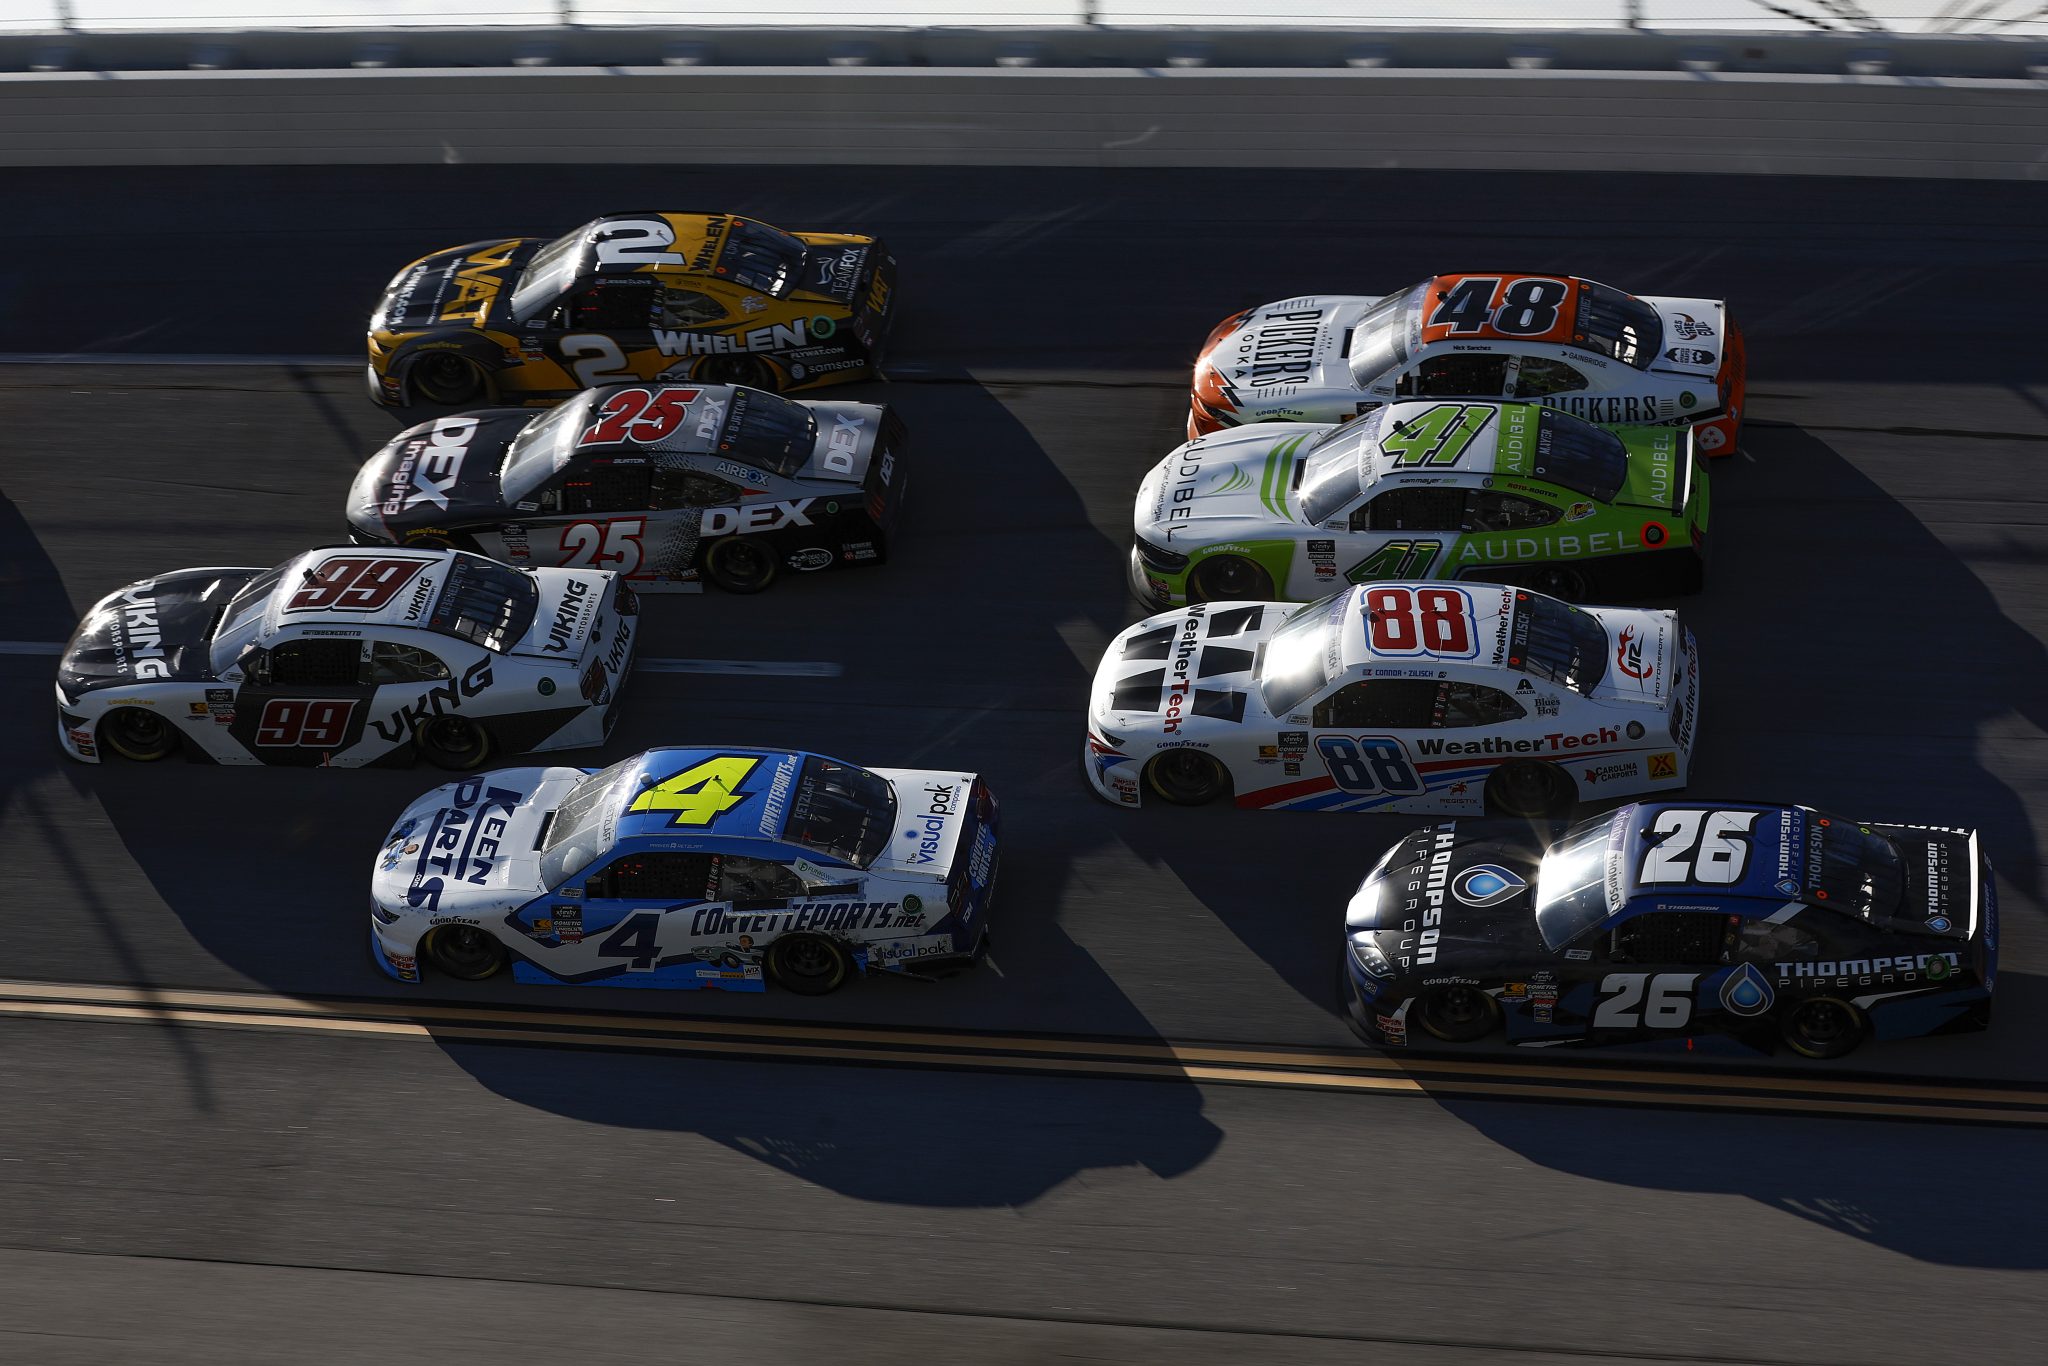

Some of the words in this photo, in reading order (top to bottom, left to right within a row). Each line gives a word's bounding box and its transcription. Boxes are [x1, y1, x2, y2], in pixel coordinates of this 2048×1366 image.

[594, 219, 686, 266] 2
[689, 217, 728, 272] WHELEN
[439, 240, 523, 332] WAT
[866, 266, 888, 314] WAT
[1427, 278, 1567, 335] 48
[558, 333, 641, 388] 2
[652, 317, 809, 358] WHELEN
[790, 347, 845, 359] FLYWAT.COM
[1249, 309, 1323, 388] PICKERS
[1568, 352, 1608, 369] GAINBRIDGE
[807, 358, 865, 374] samsara
[575, 387, 704, 450] 25
[696, 396, 727, 442] DEX
[1255, 407, 1304, 417] GOODYEAR
[1379, 404, 1498, 468] 41
[1507, 406, 1526, 473] AUDIBEL
[402, 417, 481, 512] DEX
[823, 412, 865, 476] DEX
[879, 446, 896, 489] DEX
[1651, 433, 1669, 504] AUDIBEL
[383, 440, 427, 516] imaging
[1167, 438, 1208, 543] AUDIBEL
[699, 497, 818, 538] DEX
[557, 515, 647, 581] 25
[1202, 544, 1251, 555] GOODYEAR
[1344, 539, 1444, 586] 41
[1458, 530, 1640, 561] AUDIBEL
[284, 558, 426, 610] 99
[404, 576, 434, 622] VIKING
[122, 581, 173, 680] VIKING
[543, 578, 589, 653] VIKING
[575, 592, 598, 641] MOTORSPORTS
[1367, 589, 1470, 653] 88
[1492, 590, 1513, 666] WeatherTech
[1514, 611, 1531, 647] ZILISCH
[1164, 602, 1207, 734] WeatherTech
[1409, 670, 1433, 678] ZILISCH
[1655, 626, 1665, 698] MOTORSPORTS
[255, 700, 355, 747] 99
[1535, 698, 1561, 708] Blues
[1536, 706, 1559, 717] Hog
[1679, 646, 1698, 747] WeatherTech
[1156, 739, 1210, 749] GOODYEAR
[1316, 737, 1418, 792] 88
[1416, 728, 1617, 757] WeatherTech
[629, 755, 760, 826] 4
[758, 753, 799, 838] CORVETTEPARTS.net
[1595, 763, 1638, 778] CAROLINA
[1601, 769, 1639, 782] CARPORTS
[1651, 770, 1676, 779] KOA
[406, 776, 485, 913] PARTS
[468, 785, 524, 887] KEEN
[1639, 809, 1760, 884] 26
[1779, 809, 1791, 878] THOMPSON
[1791, 811, 1801, 880] PIPEGROUP
[1807, 825, 1825, 890] THOMPSON
[1398, 824, 1431, 968] PIPEGROUP
[1416, 820, 1458, 966] THOMPSON
[1927, 840, 1940, 915] THOMPSON
[1940, 843, 1949, 915] PIPEGROUP
[429, 916, 481, 926] GOODYEAR
[598, 911, 664, 970] 4
[744, 966, 760, 974] WIX
[1422, 976, 1480, 986] GOODYEAR
[1775, 952, 1959, 978] THOMPSON
[1778, 967, 1961, 989] PIPEGROP
[1592, 972, 1702, 1029] 26
